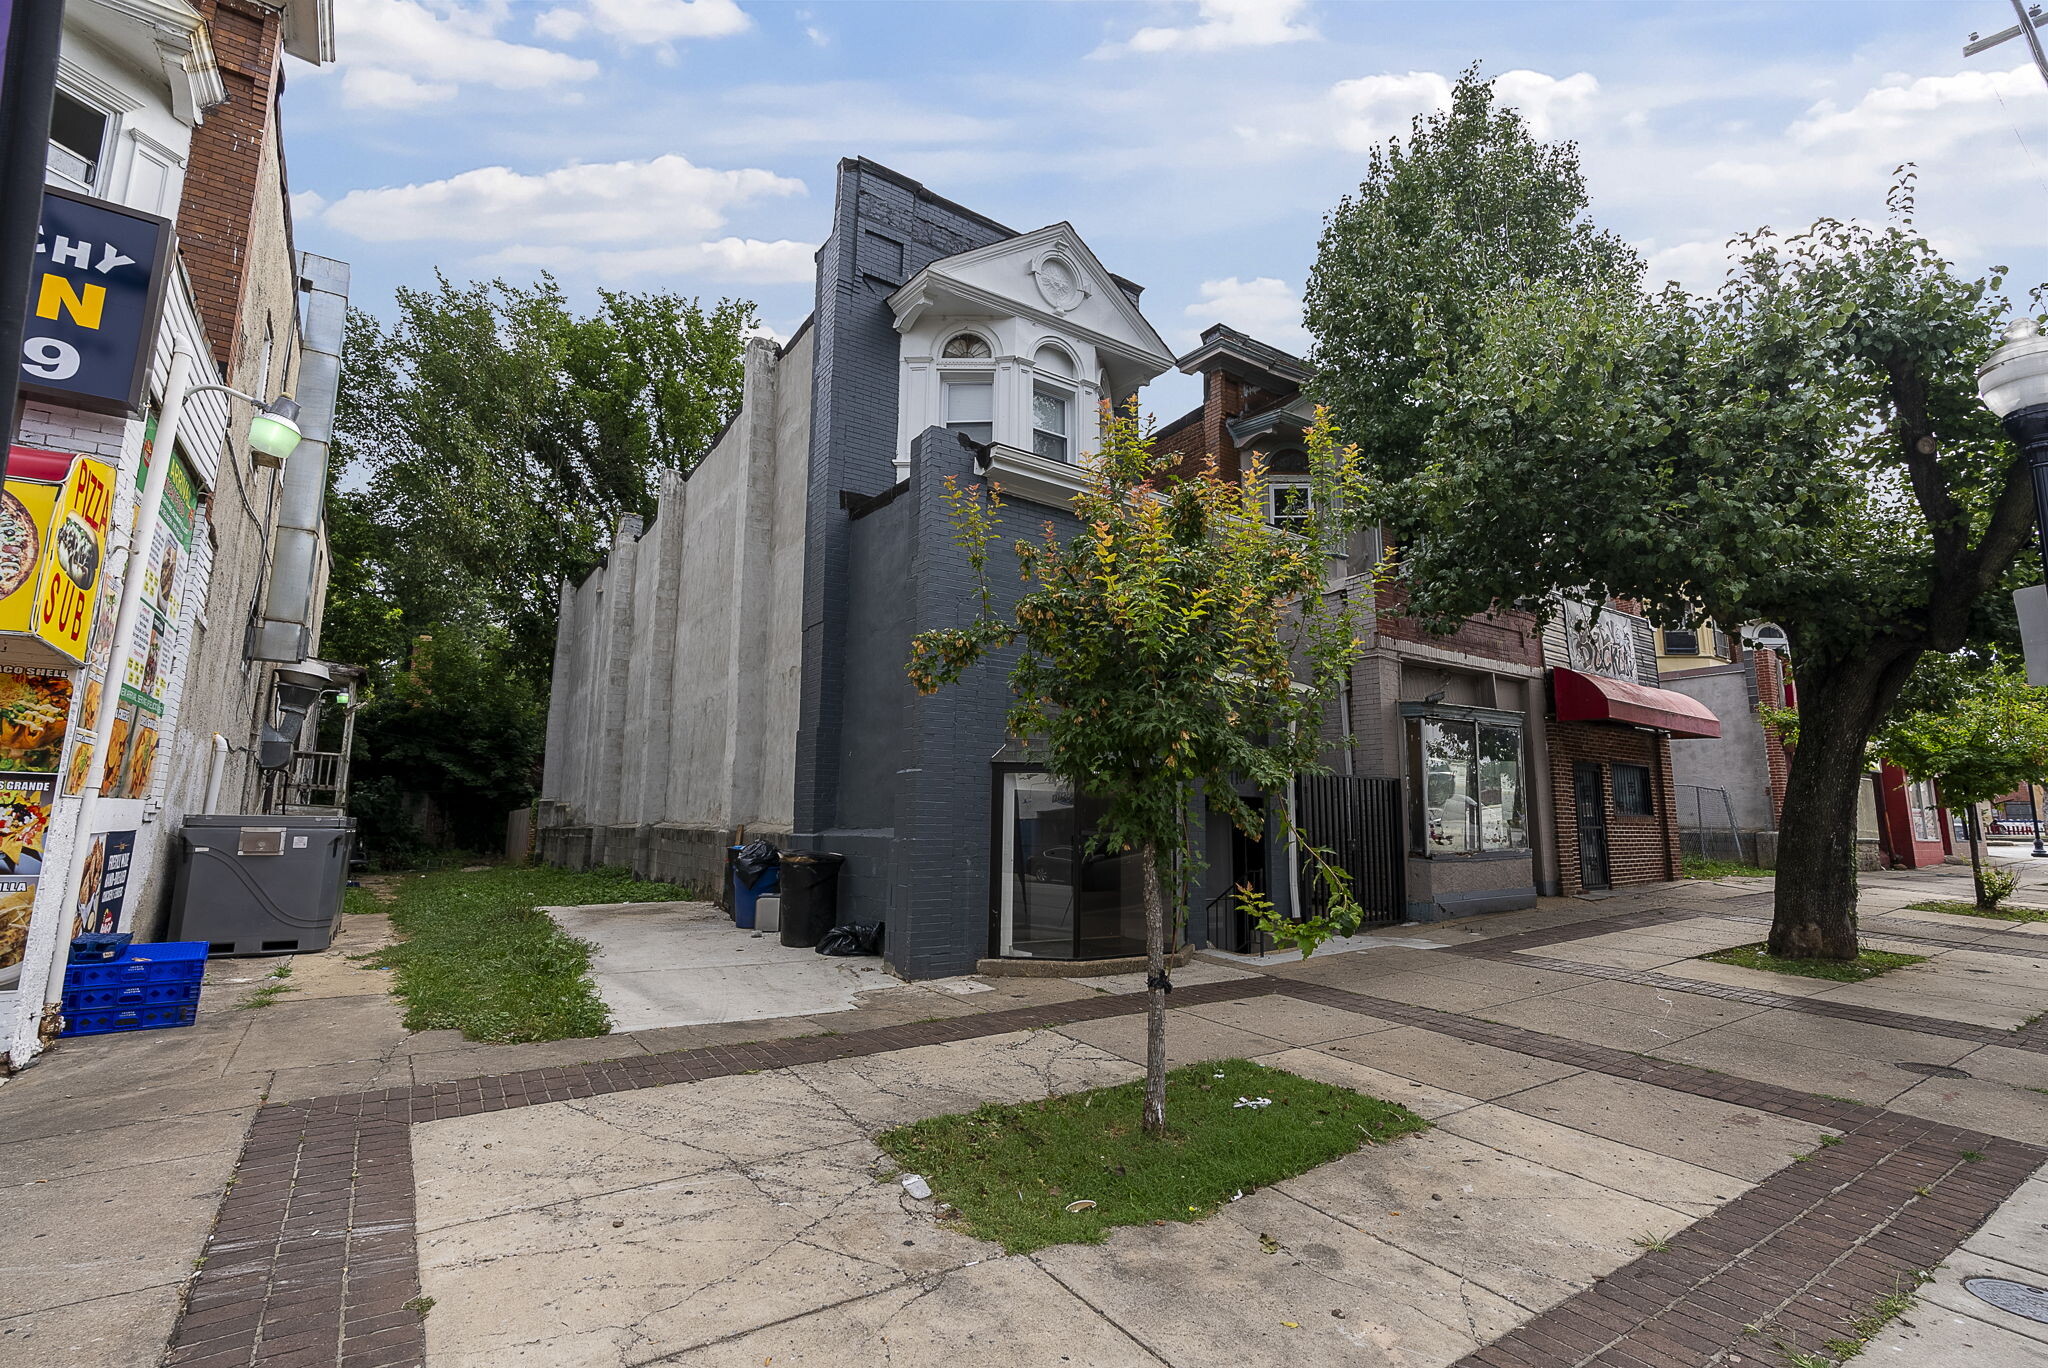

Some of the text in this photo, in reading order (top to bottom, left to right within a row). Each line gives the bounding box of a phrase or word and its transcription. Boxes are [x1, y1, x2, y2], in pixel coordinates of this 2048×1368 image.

[36, 273, 107, 330] N
[21, 336, 81, 380] 9
[74, 459, 111, 539] PIZZA
[43, 572, 85, 642] SUB
[0, 664, 69, 679] CO SHELL
[6, 781, 51, 791] GRANDE
